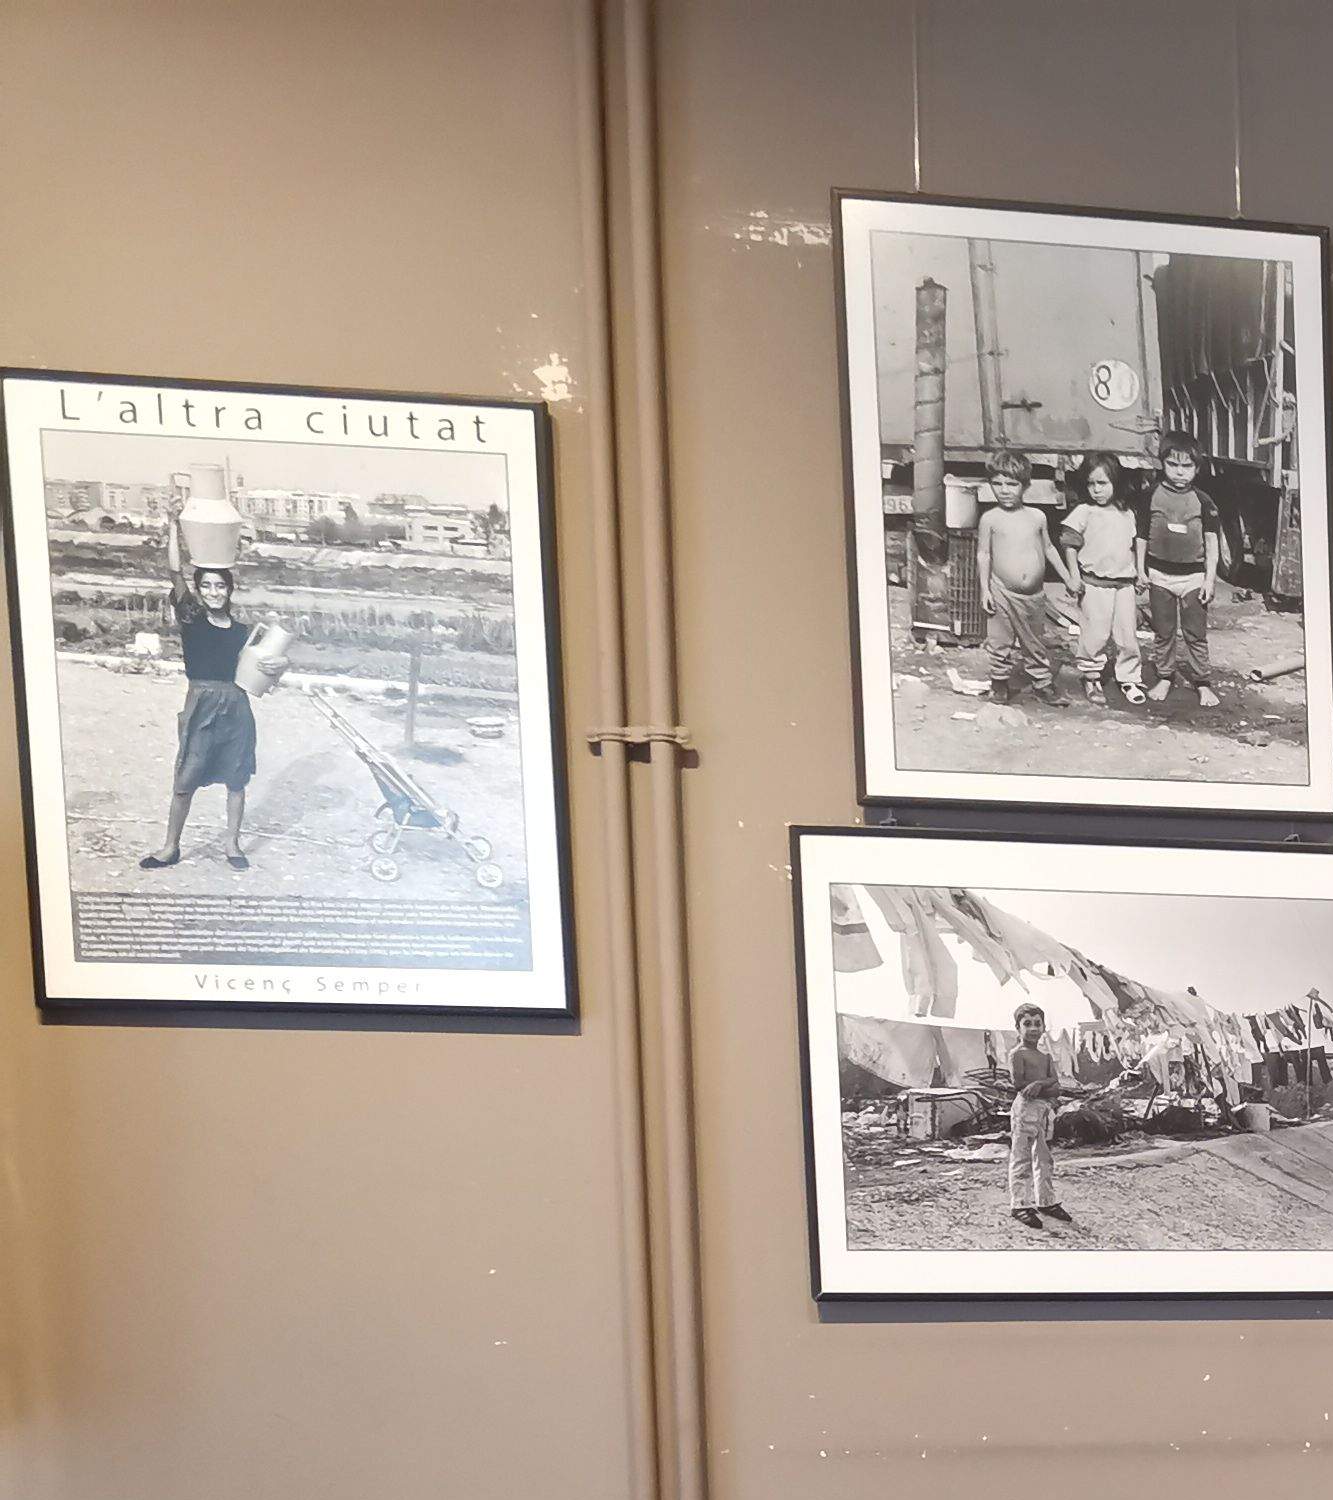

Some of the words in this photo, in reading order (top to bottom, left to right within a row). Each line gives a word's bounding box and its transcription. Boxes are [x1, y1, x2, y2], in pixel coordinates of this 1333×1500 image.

[60, 388, 263, 430] L'altra
[306, 404, 488, 443] ciutat
[194, 973, 292, 995] Vicenç
[316, 975, 423, 996] Semper
